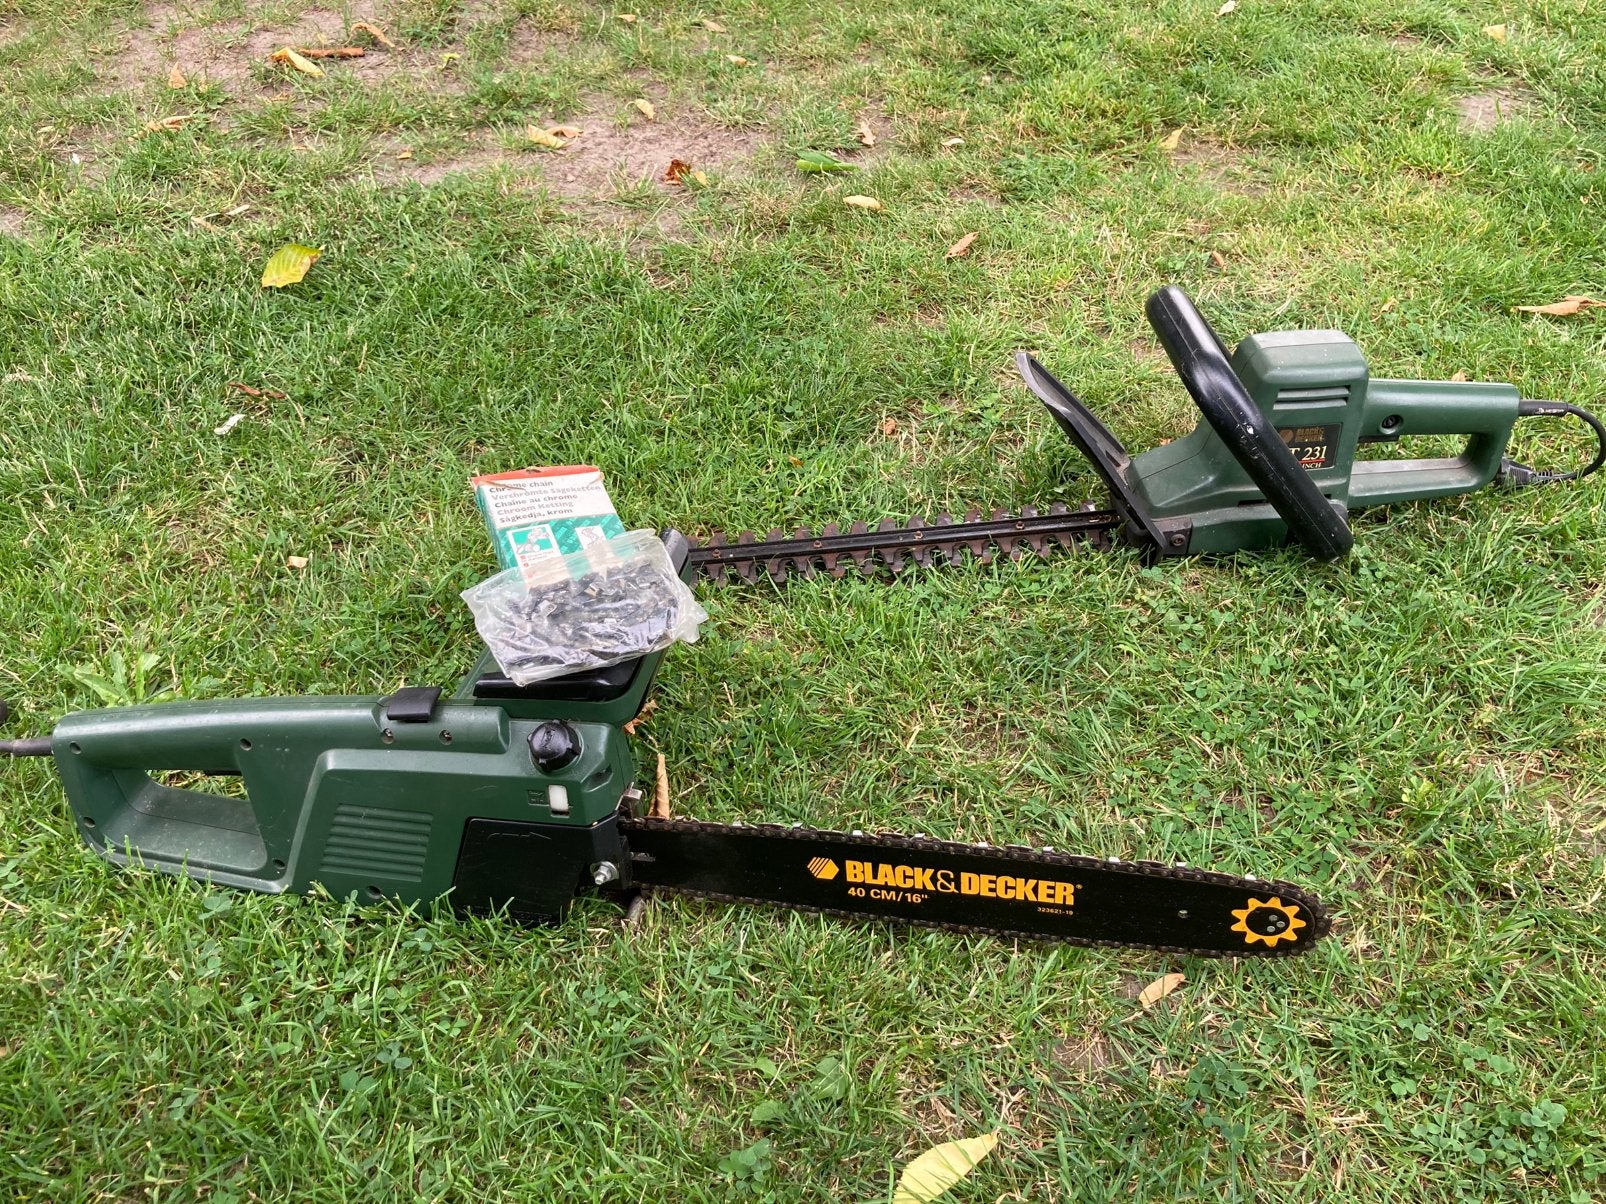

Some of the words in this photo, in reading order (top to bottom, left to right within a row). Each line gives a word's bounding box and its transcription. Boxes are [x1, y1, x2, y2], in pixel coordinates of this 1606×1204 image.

[1302, 445, 1327, 460] 231
[543, 494, 578, 502] chrome
[497, 505, 536, 515] Chroom
[538, 501, 574, 510] Ketting
[848, 886, 866, 898] 40
